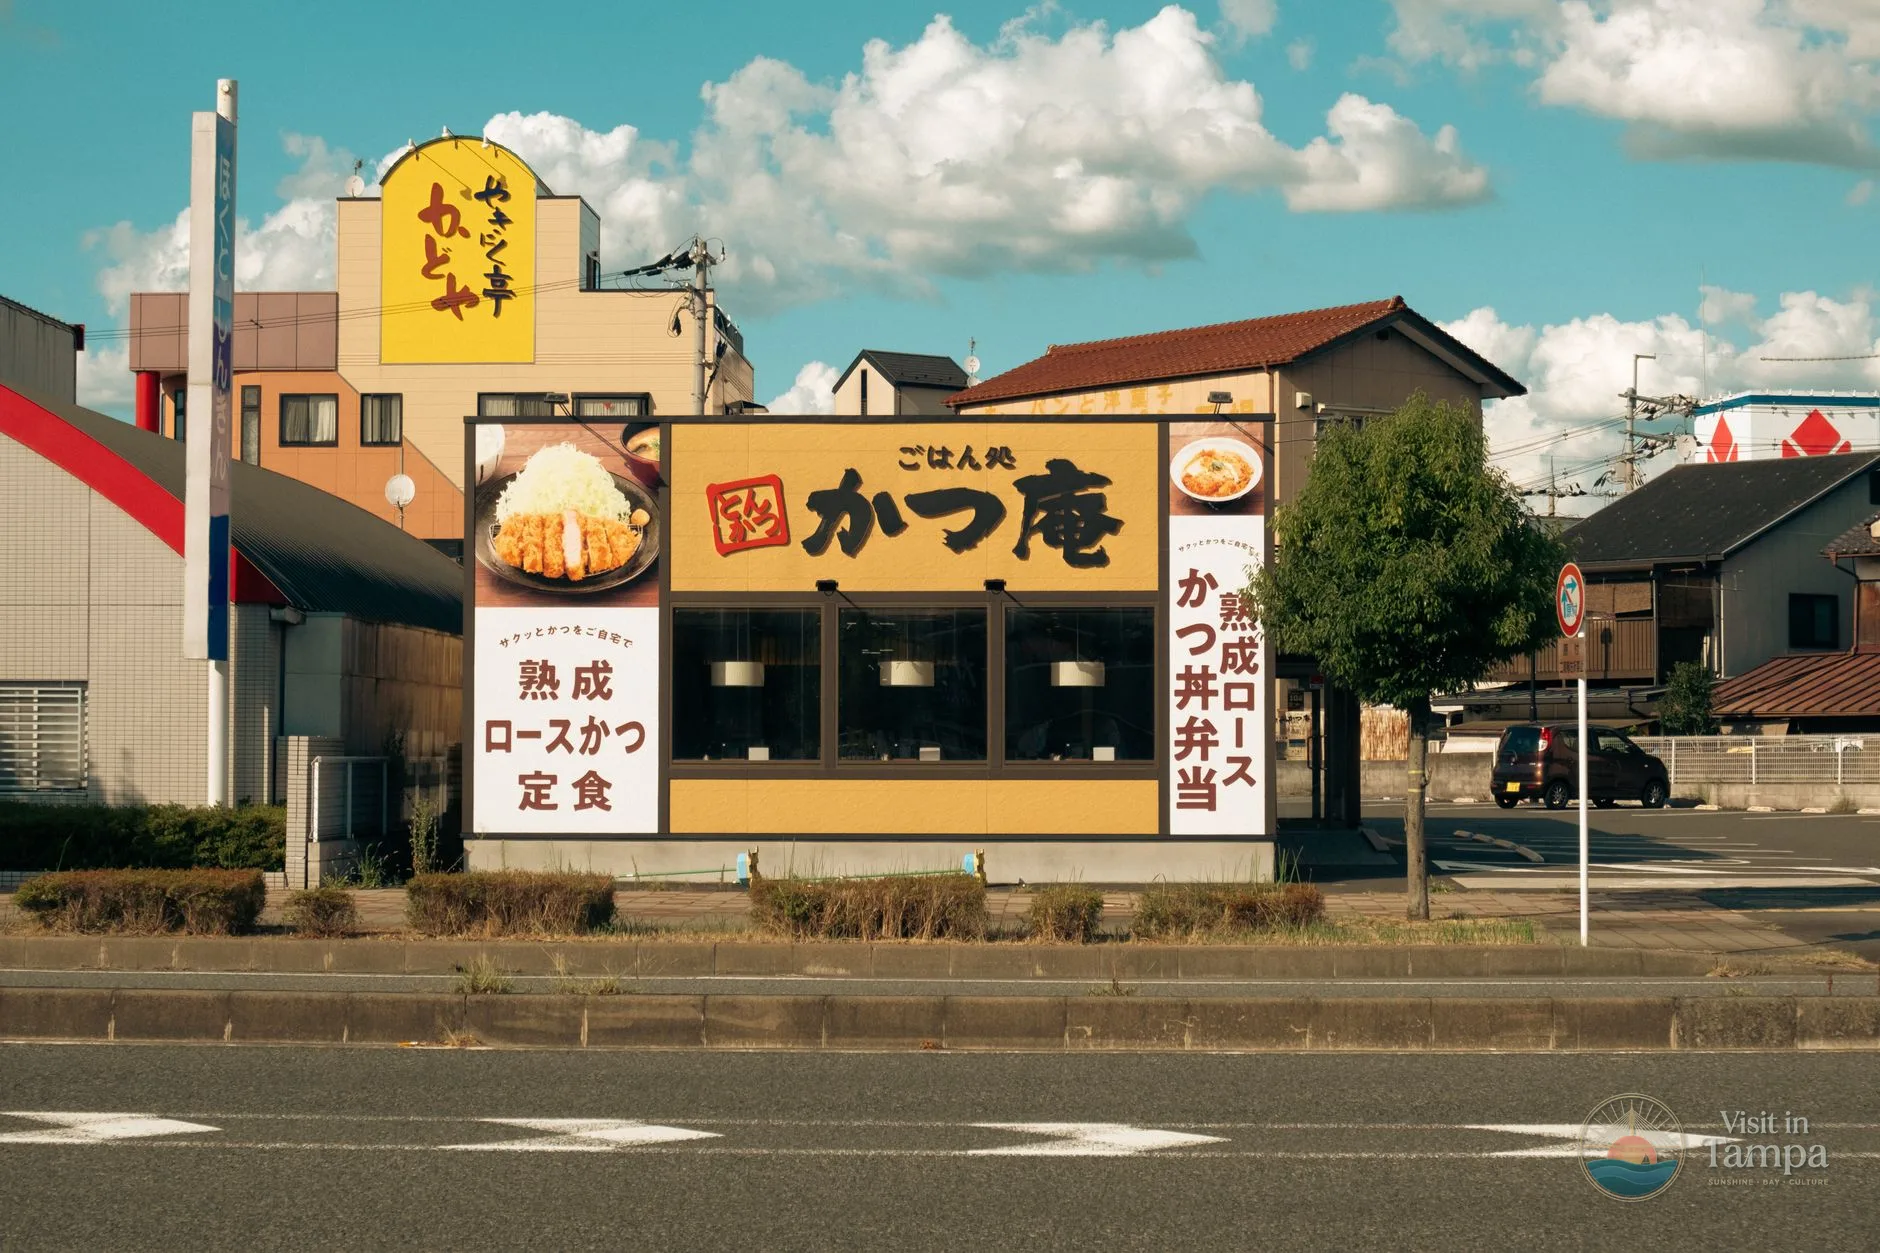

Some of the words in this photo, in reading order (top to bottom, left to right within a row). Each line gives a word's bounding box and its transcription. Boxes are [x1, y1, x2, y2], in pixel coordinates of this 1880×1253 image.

[418, 182, 480, 321] かどや
[474, 175, 517, 318] やきにく亭
[898, 444, 1018, 471] ごはん処
[801, 457, 1125, 569] かつ庵
[499, 624, 633, 649] サクッとかつをご自宅で
[518, 659, 614, 701] 熟成
[1174, 568, 1219, 812] かつ丼弁当
[1219, 591, 1260, 788] 熟成ロース
[485, 715, 646, 756] ロースかつ
[518, 769, 613, 812] 定食
